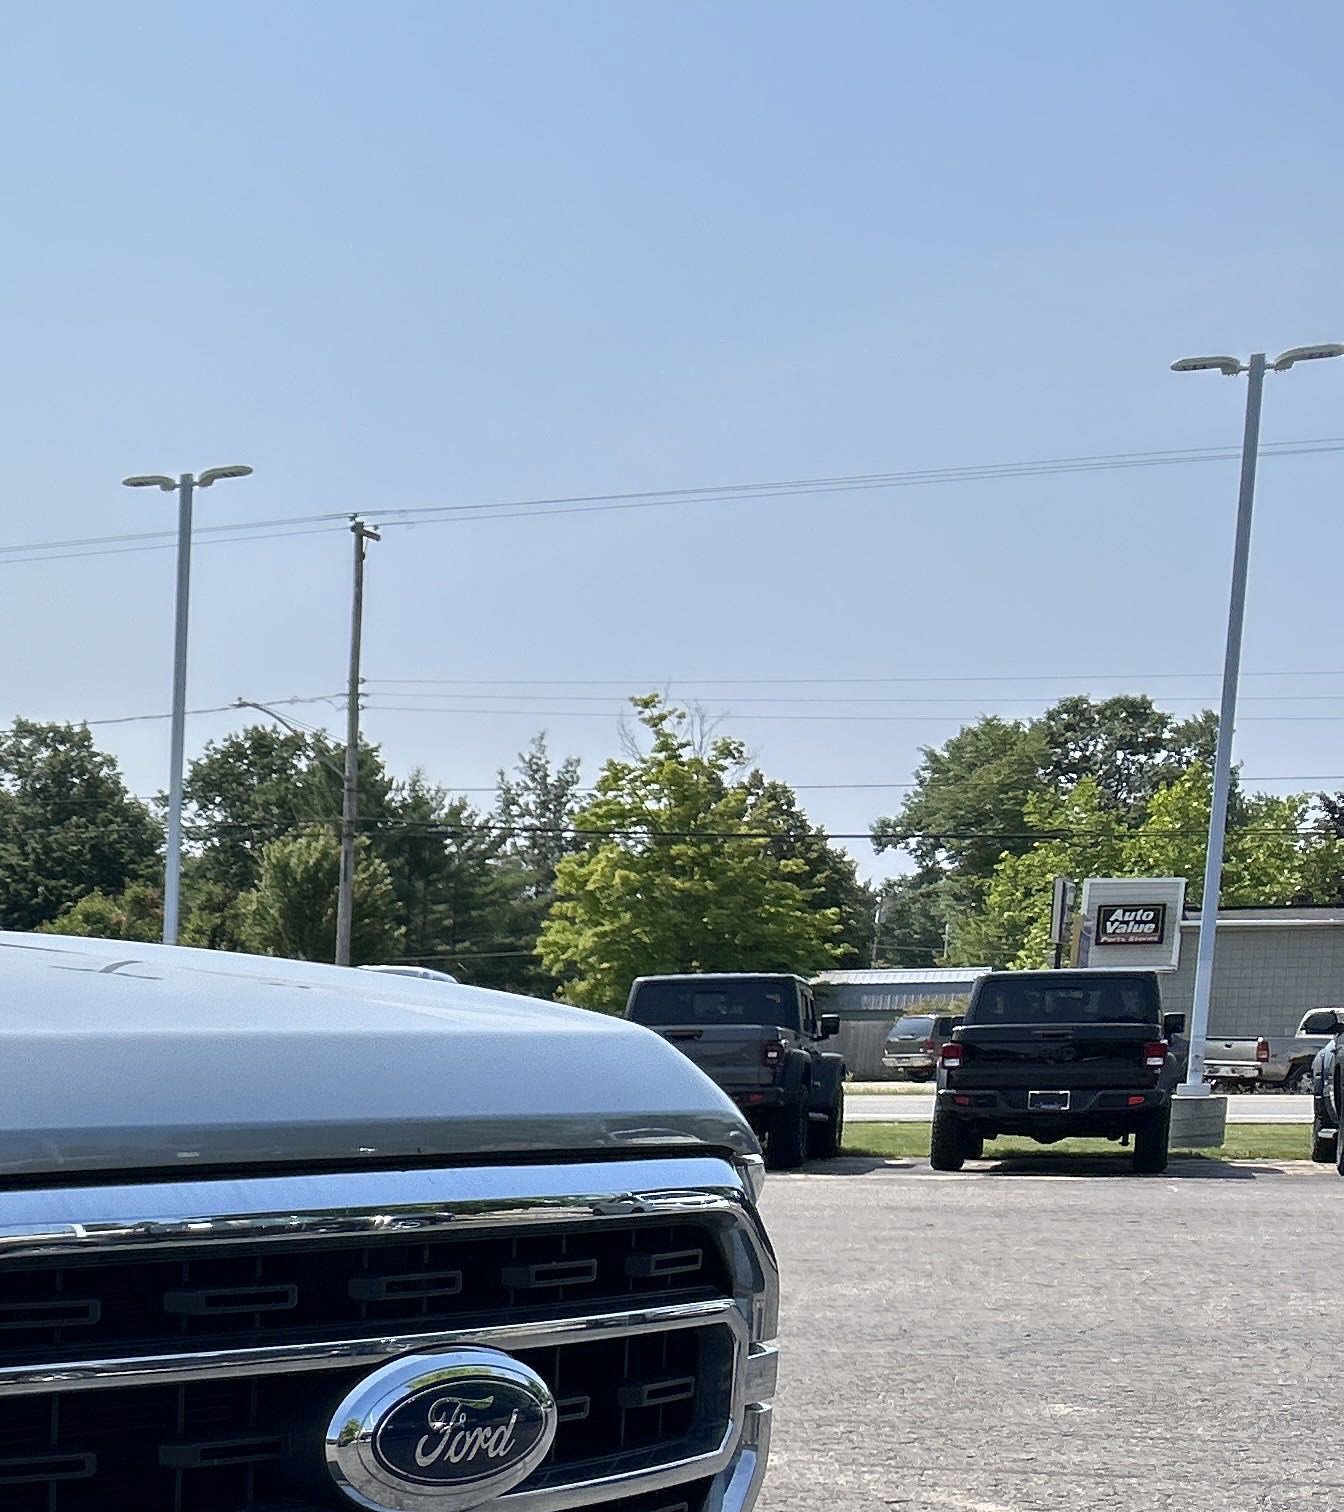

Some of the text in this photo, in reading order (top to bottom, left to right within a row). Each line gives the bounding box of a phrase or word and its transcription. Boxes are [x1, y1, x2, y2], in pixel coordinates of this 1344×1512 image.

[1109, 909, 1154, 921] Auto
[1105, 921, 1156, 934] Value
[415, 1396, 519, 1467] Ford
